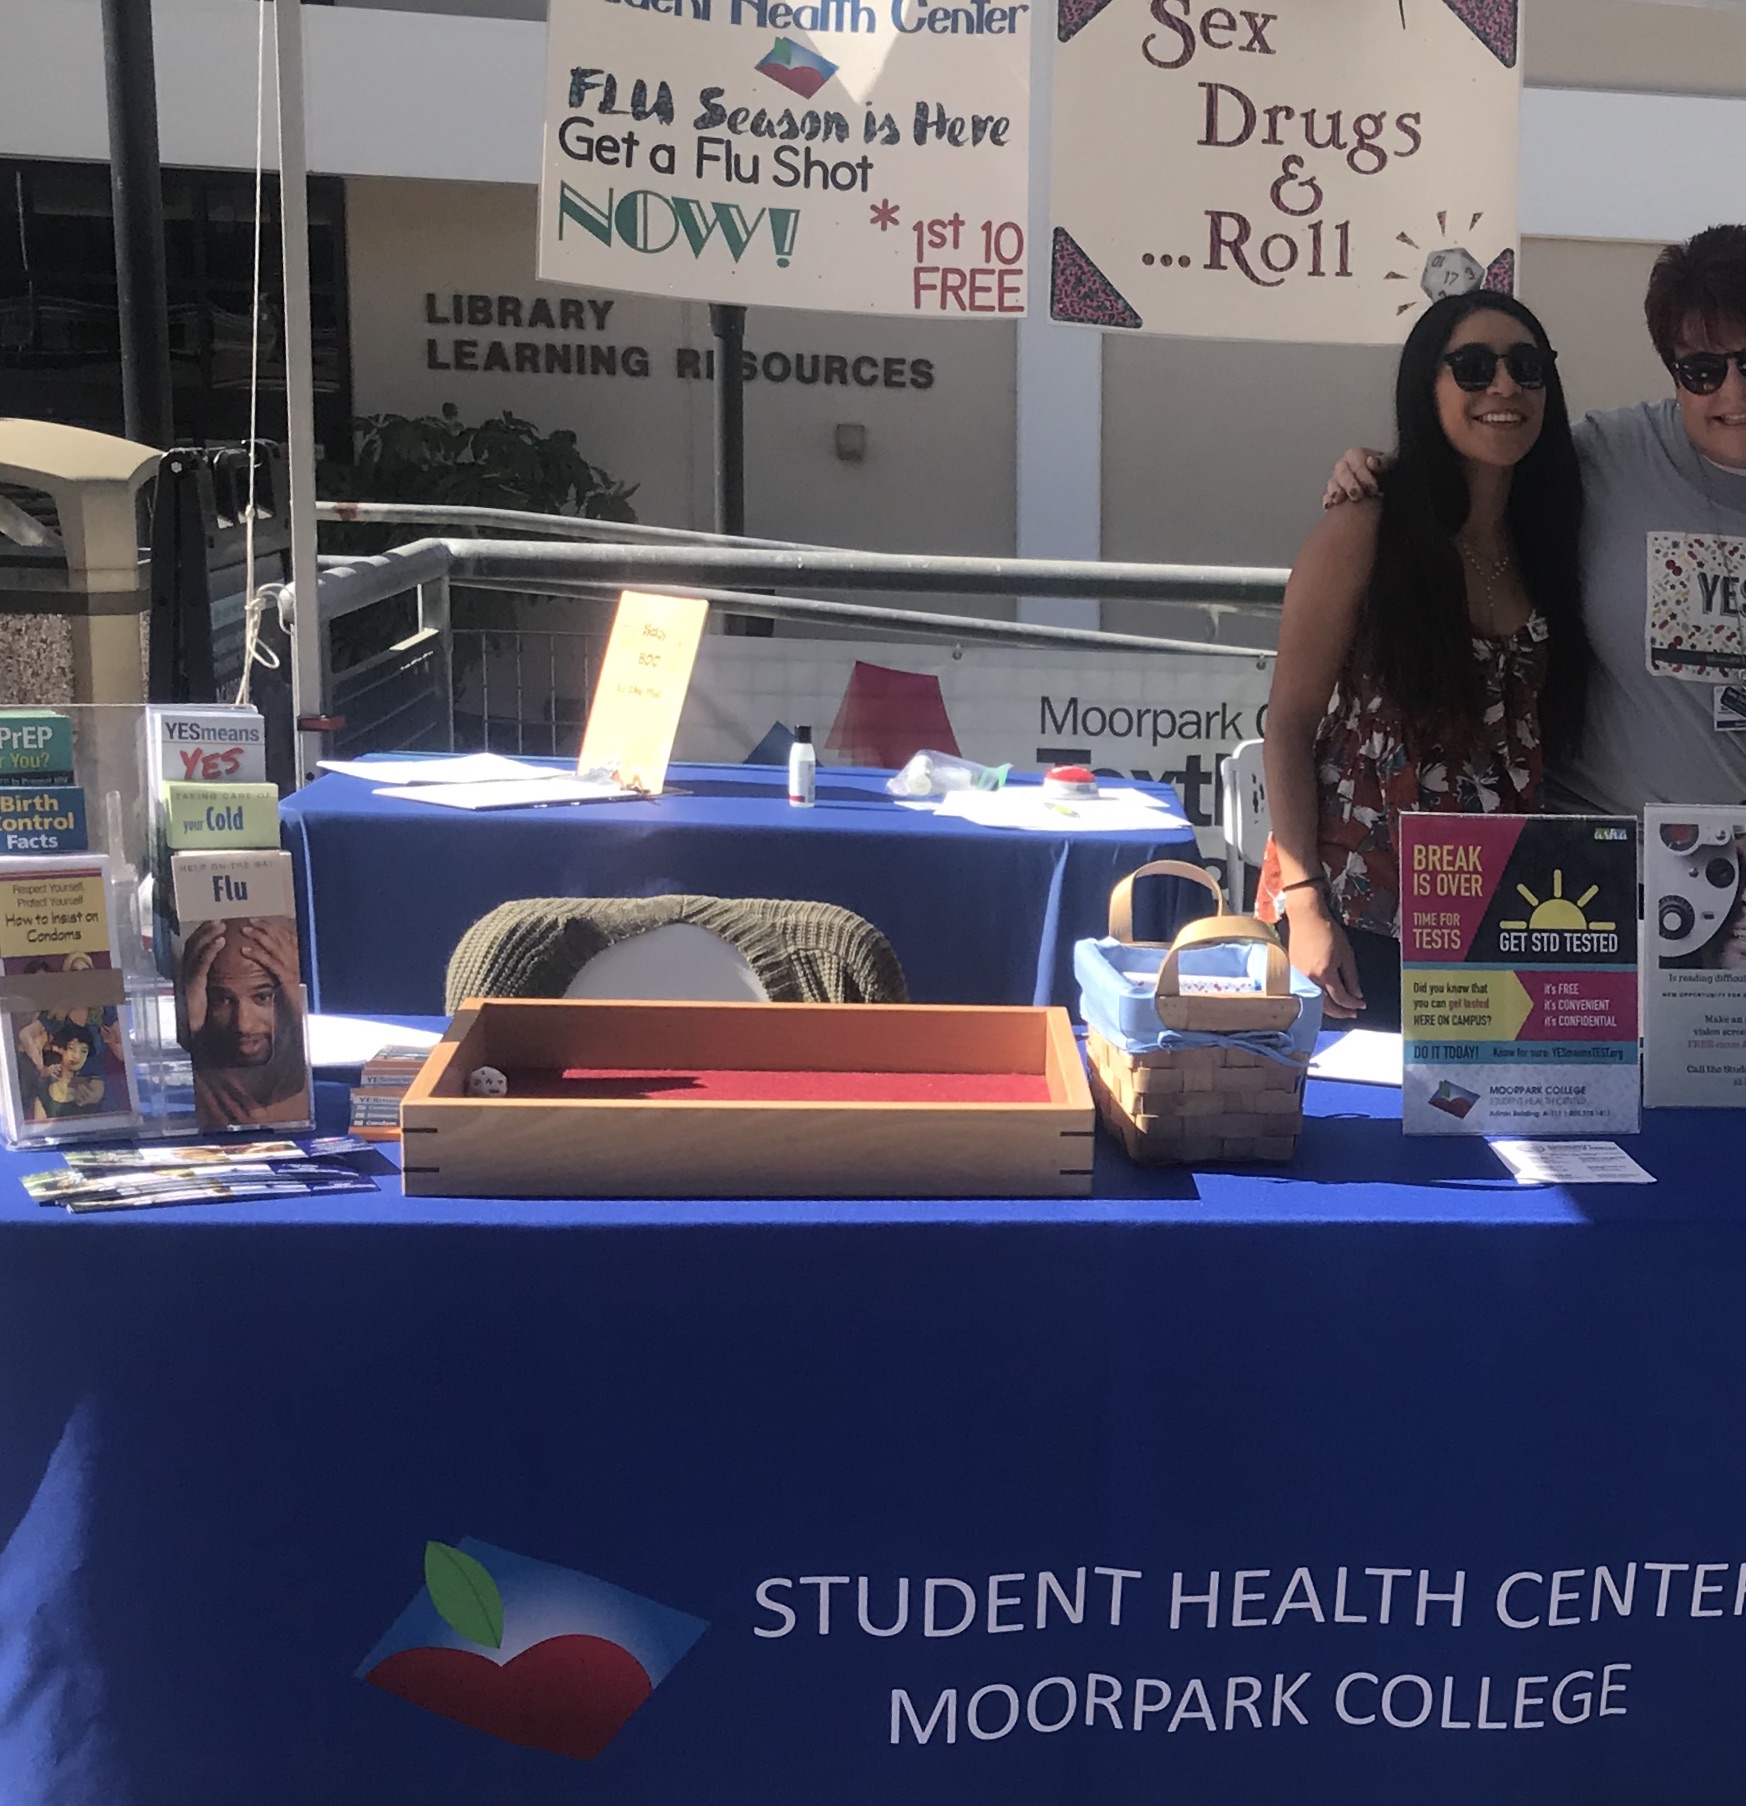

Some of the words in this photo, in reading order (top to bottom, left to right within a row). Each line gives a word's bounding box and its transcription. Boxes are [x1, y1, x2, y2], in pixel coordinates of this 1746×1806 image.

[891, 0, 1030, 36] Center
[1142, 0, 1278, 70] Sex
[568, 67, 674, 126] FLU
[694, 87, 850, 144] Season
[865, 102, 900, 145] is
[914, 101, 1011, 148] Here
[1197, 81, 1422, 175] Drugs
[558, 116, 640, 168] Get
[649, 143, 676, 174] a
[696, 137, 760, 185] Flu
[772, 145, 875, 192] Shot
[1270, 154, 1323, 217] &
[559, 180, 800, 269] NOW!
[913, 212, 965, 264] 1st
[982, 220, 1025, 265] 10
[913, 266, 1025, 313] FREE
[426, 293, 615, 331] LIBRARY
[426, 338, 650, 378] LEARNING
[1040, 695, 1243, 746] Moorpark
[9, 752, 51, 769] You?
[179, 747, 244, 780] YES
[0, 794, 59, 812] Birth
[206, 805, 244, 831] Cold
[6, 833, 59, 850] Facts
[1413, 844, 1483, 872] BREAK
[212, 875, 248, 902] Flu
[1413, 873, 1431, 896] IS
[1436, 873, 1483, 897] OVER
[5, 912, 33, 927] How
[35, 914, 49, 925] to
[50, 911, 83, 925] Insist
[84, 912, 99, 922] on
[1413, 912, 1437, 926] TIME
[1440, 912, 1460, 926] FOR
[26, 927, 82, 943] Condoms
[1413, 929, 1461, 950] TESTS
[1500, 932, 1528, 952] GET
[1531, 932, 1559, 952] STD
[1564, 932, 1618, 953] TESTED
[1413, 982, 1427, 994] Did
[1429, 984, 1445, 996] you
[1447, 982, 1469, 994] know
[1471, 982, 1488, 994] that
[1558, 983, 1580, 995] FREE
[1669, 973, 1678, 982] Is
[1679, 973, 1714, 985] reading
[1413, 999, 1429, 1011] you
[1431, 1000, 1447, 1008] can
[1463, 998, 1490, 1009] tested
[1558, 999, 1610, 1011] CONVENIENT
[1413, 1014, 1436, 1026] HERE
[1437, 1014, 1450, 1026] ON
[1451, 1014, 1493, 1026] CAMPUS?
[1558, 1015, 1617, 1027] CONFIDENTIAL
[1705, 1015, 1729, 1024] Make
[1731, 1016, 1744, 1024] an
[1414, 1045, 1429, 1059] DO
[1431, 1045, 1441, 1059] IT
[1442, 1045, 1479, 1060] TODAY!
[1687, 1065, 1706, 1074] Call
[1707, 1065, 1722, 1074] the
[1489, 1085, 1543, 1095] MOORPARK
[1545, 1085, 1587, 1095] COLLEGE
[752, 1565, 1142, 1640] STUDENT
[1168, 1565, 1466, 1631] HEALTH
[888, 1671, 1311, 1746] MOORPARK
[1333, 1662, 1632, 1731] COLLEGE
